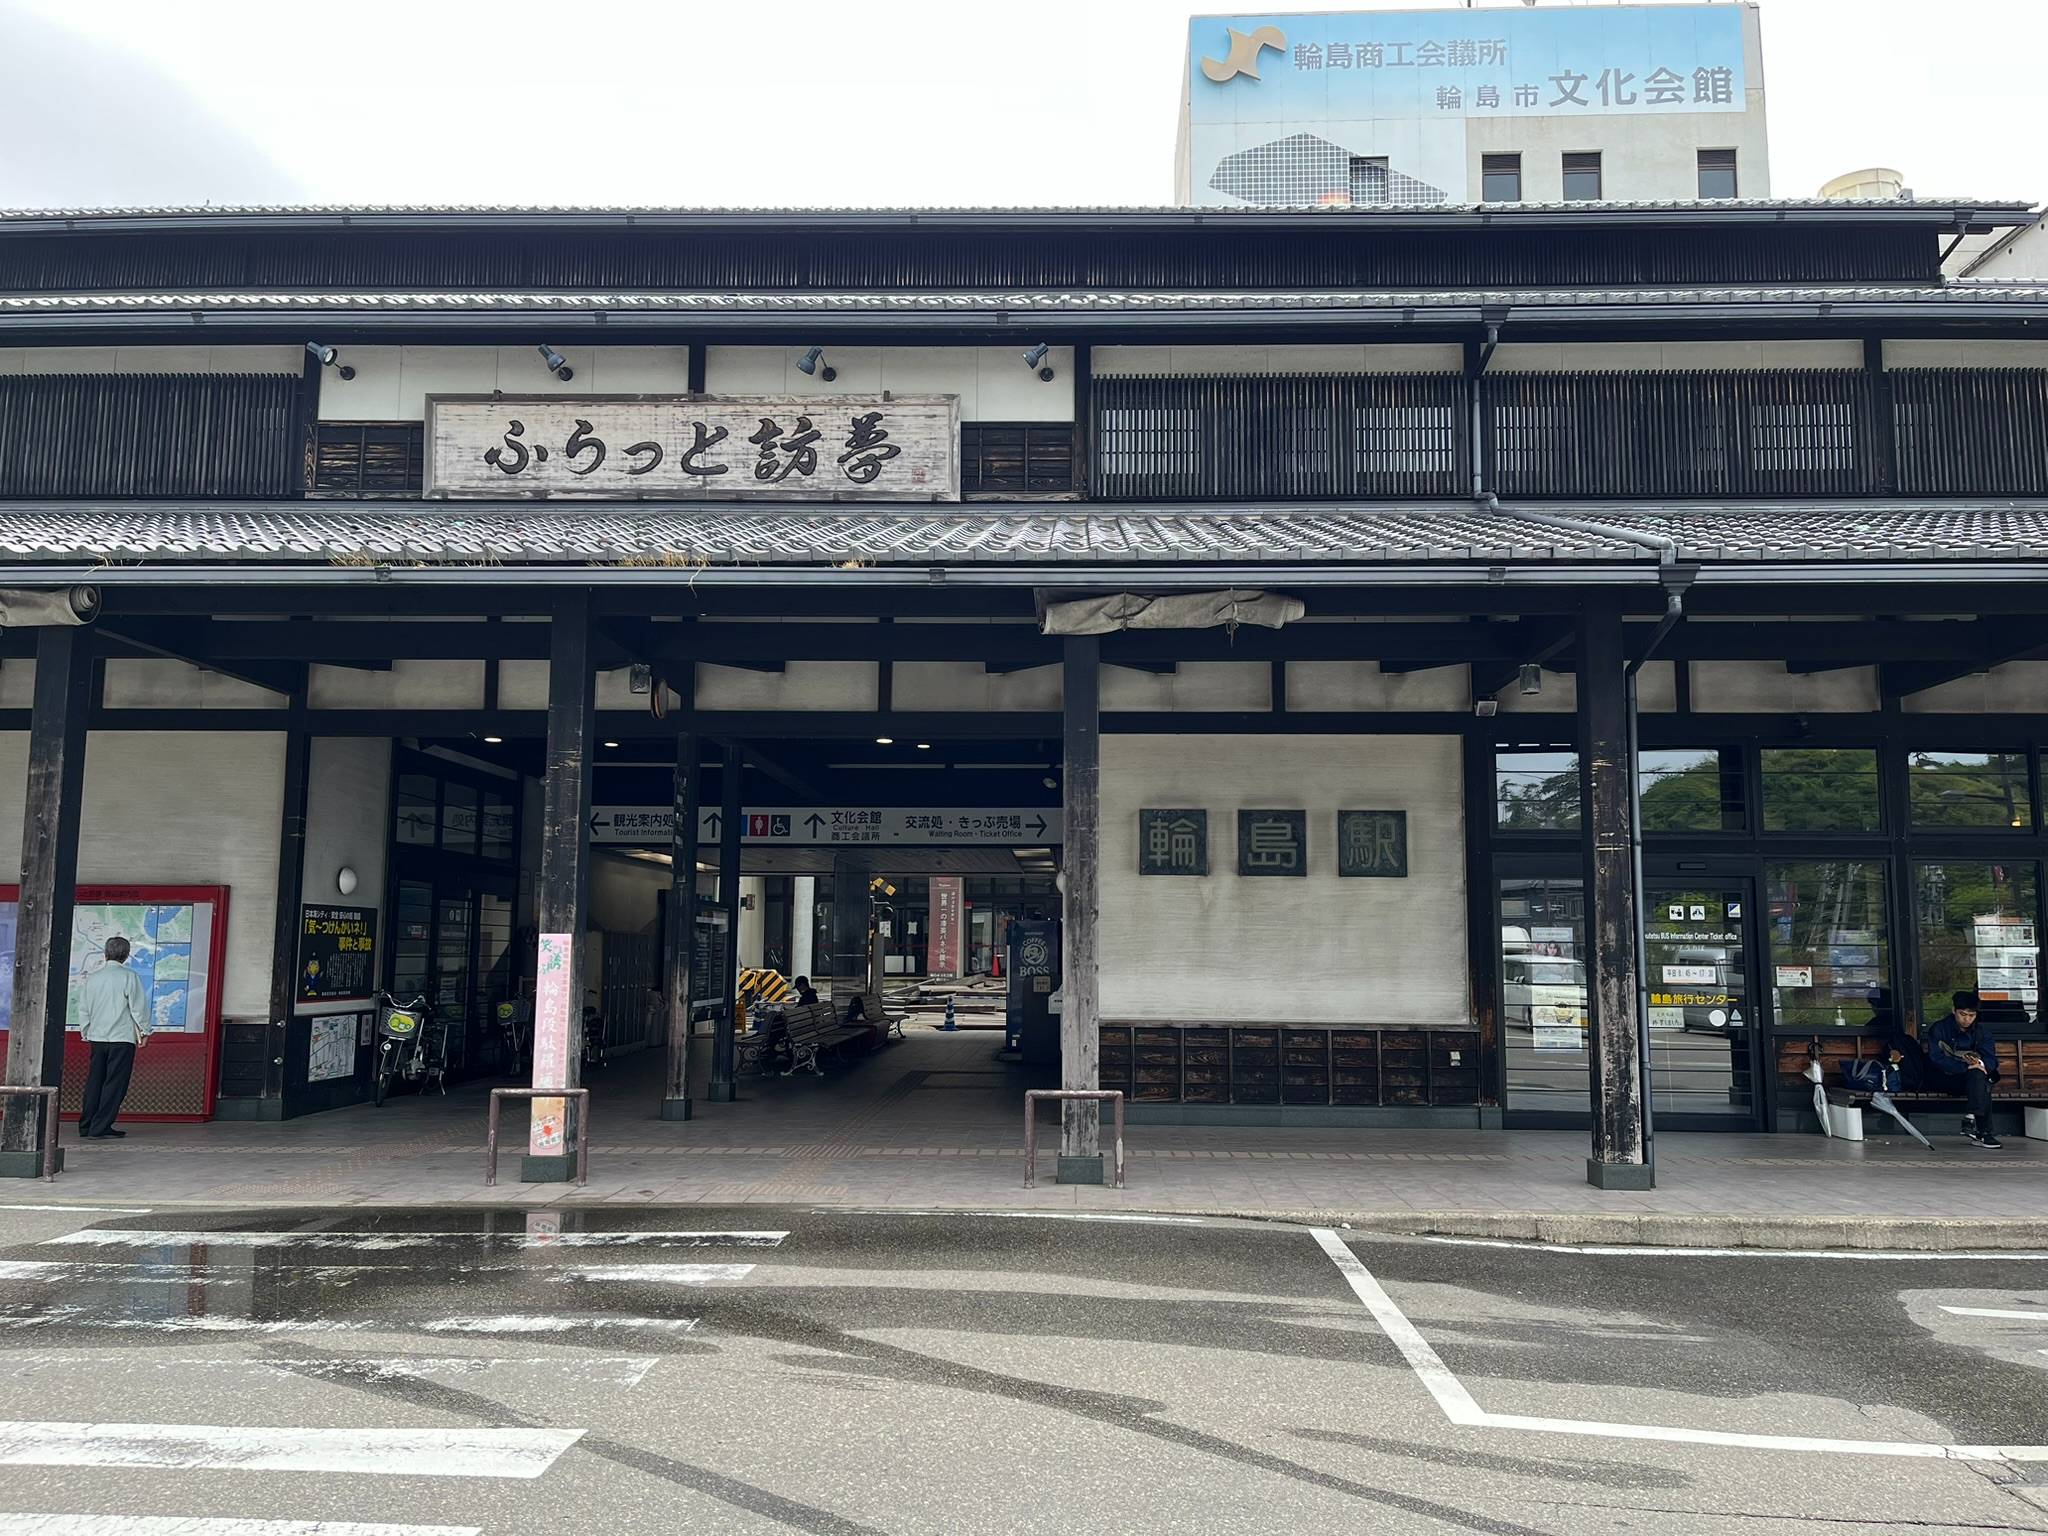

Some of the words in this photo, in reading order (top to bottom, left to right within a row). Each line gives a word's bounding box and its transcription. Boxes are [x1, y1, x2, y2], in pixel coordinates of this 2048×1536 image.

[1293, 39, 1507, 70] 輪島商工会議所
[484, 410, 901, 484] ふらっと訪夢
[831, 810, 882, 825] 文化会館
[905, 815, 1021, 829] 交流処・きっぷ売場
[614, 828, 639, 837] Tourist
[640, 828, 673, 837] Informati
[831, 831, 880, 841] 商工会議所
[928, 830, 952, 838] Waiting
[1660, 932, 1669, 940] BUS
[1670, 932, 1694, 940] Information
[1694, 932, 1709, 940] Center
[1709, 932, 1724, 940] Ticket
[1724, 932, 1738, 940] office
[1020, 966, 1050, 977] BOSS
[1650, 993, 1738, 1005] 輪島旅行センター
